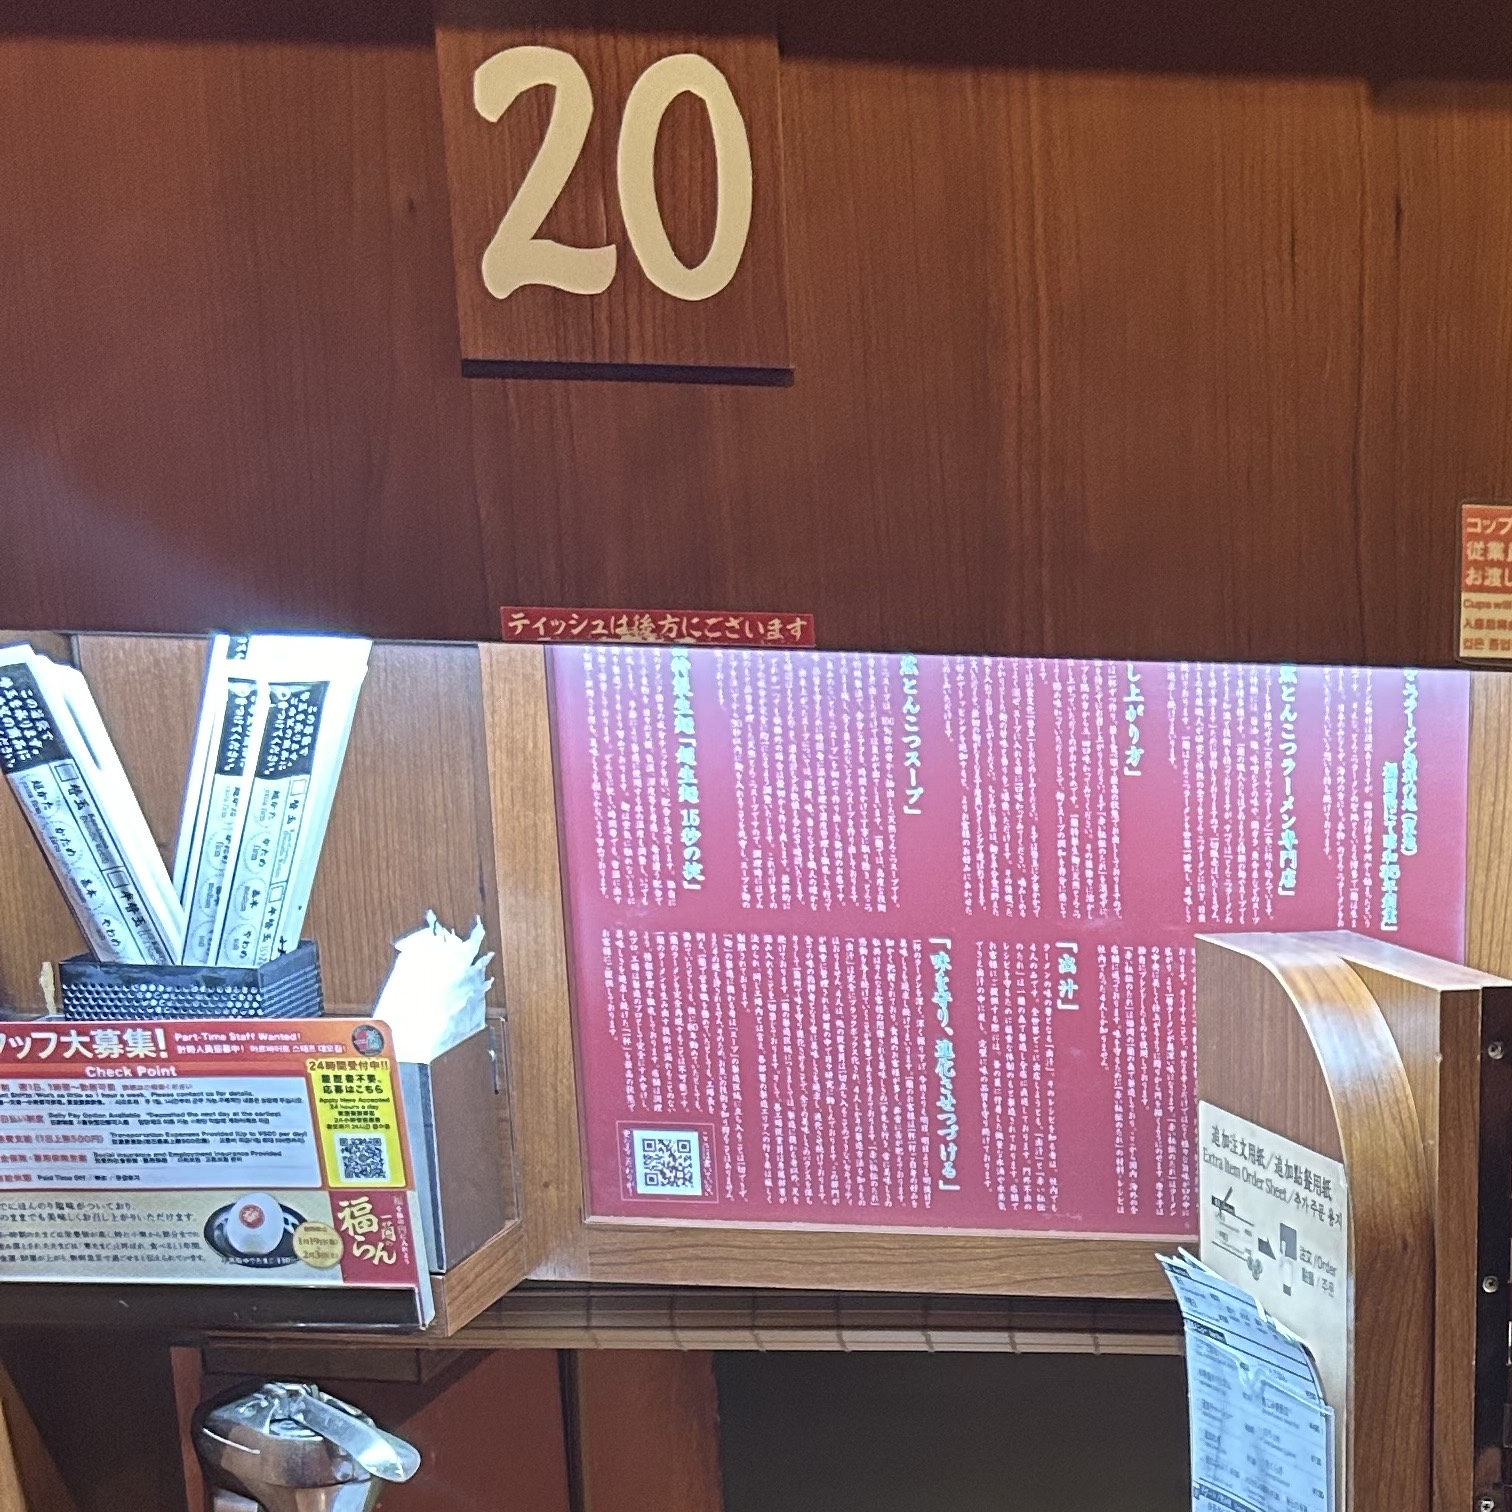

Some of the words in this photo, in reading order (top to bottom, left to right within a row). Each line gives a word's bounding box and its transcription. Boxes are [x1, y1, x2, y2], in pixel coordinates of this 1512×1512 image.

[473, 45, 753, 302] 20
[1463, 598, 1491, 611] Cups
[1493, 599, 1512, 610] will
[508, 613, 807, 641] ティッシュは後方にございます
[55, 827, 77, 857] かため
[101, 917, 122, 948] やわめ
[174, 1032, 227, 1042] Part-Time
[228, 1033, 256, 1042] Staff
[258, 1033, 301, 1042] Wanted!
[85, 1066, 133, 1078] Check
[136, 1066, 178, 1077] Point
[308, 1060, 389, 1072] 24時間受付中!!
[323, 1085, 384, 1094] 応募はこちら
[1203, 1147, 1224, 1173] Extra
[1224, 1156, 1241, 1180] Item
[1242, 1166, 1264, 1189] Order
[1265, 1178, 1287, 1202] Sheet
[338, 1196, 397, 1266] 福らん
